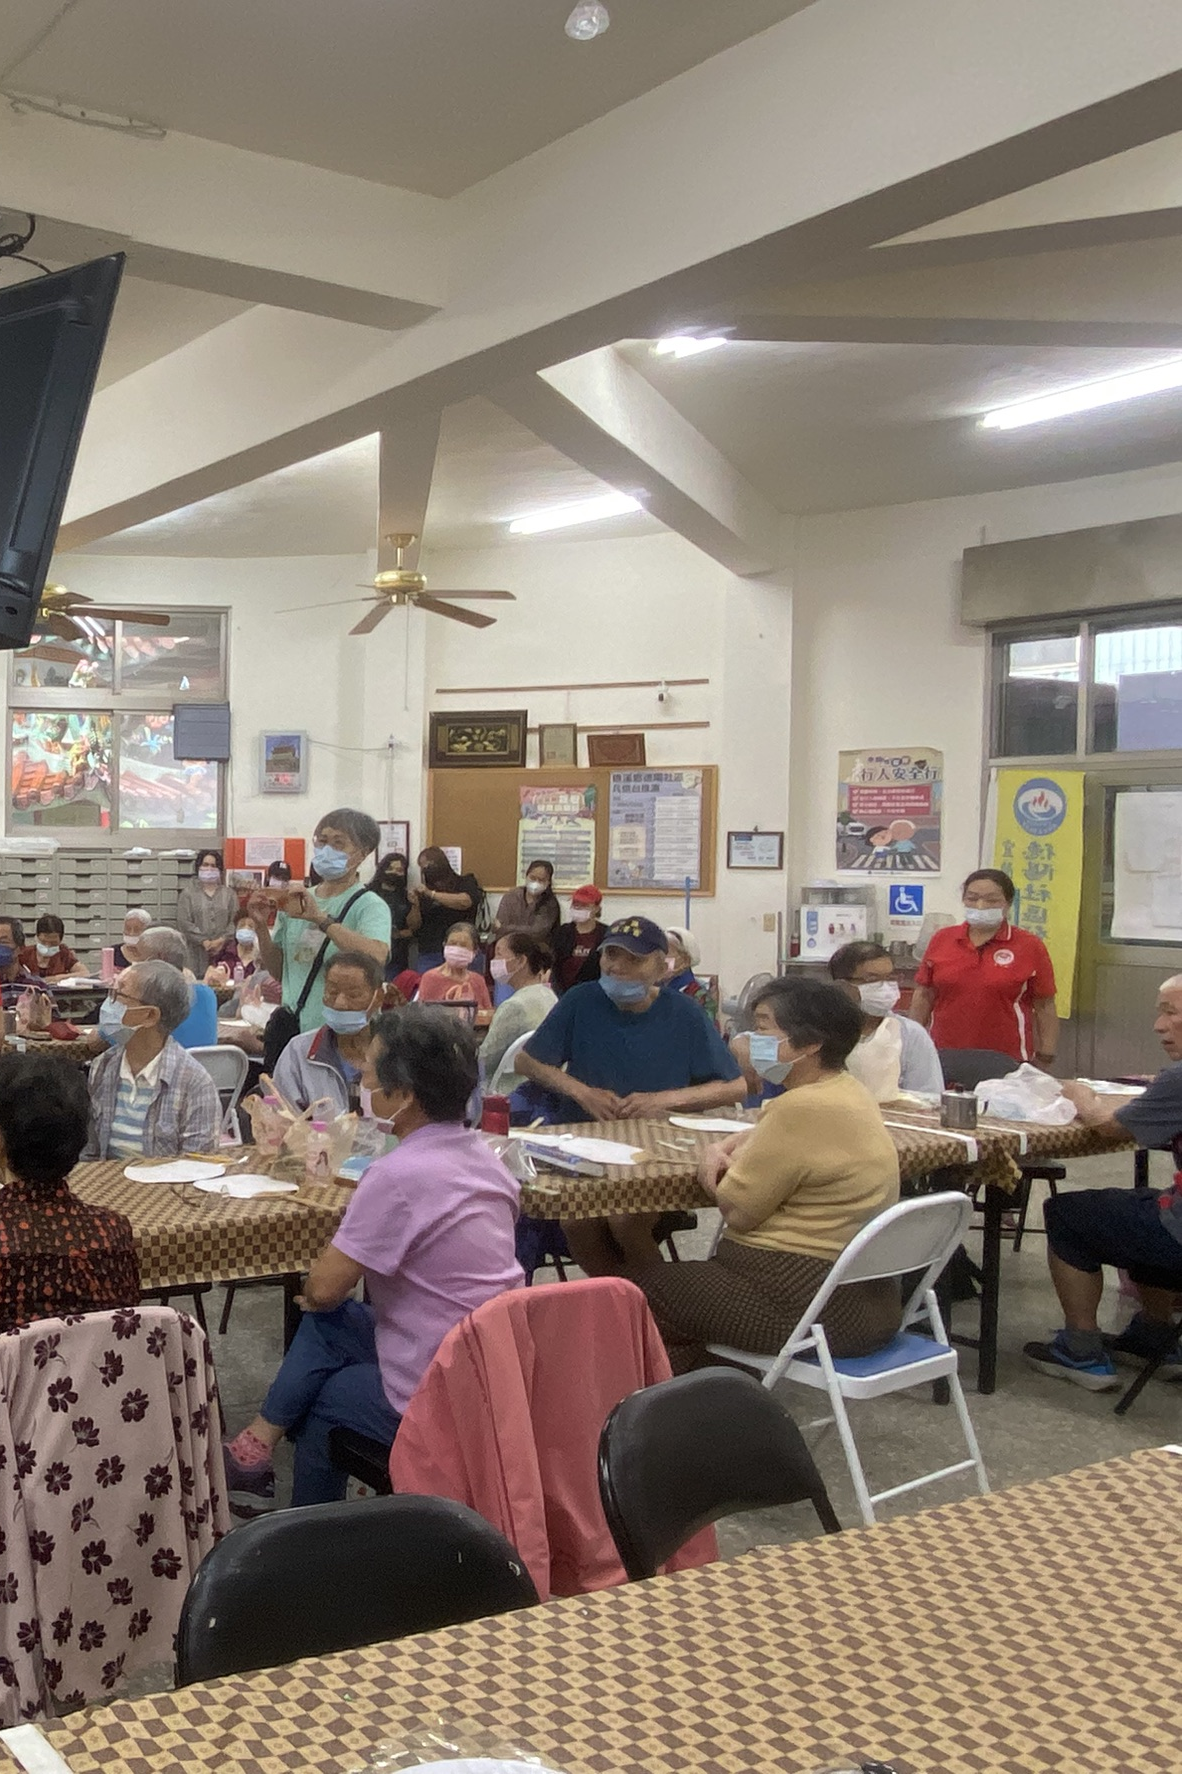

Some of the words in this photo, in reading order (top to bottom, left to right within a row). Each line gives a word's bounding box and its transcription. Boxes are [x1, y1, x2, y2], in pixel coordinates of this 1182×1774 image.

[861, 766, 937, 781] 行人安全行
